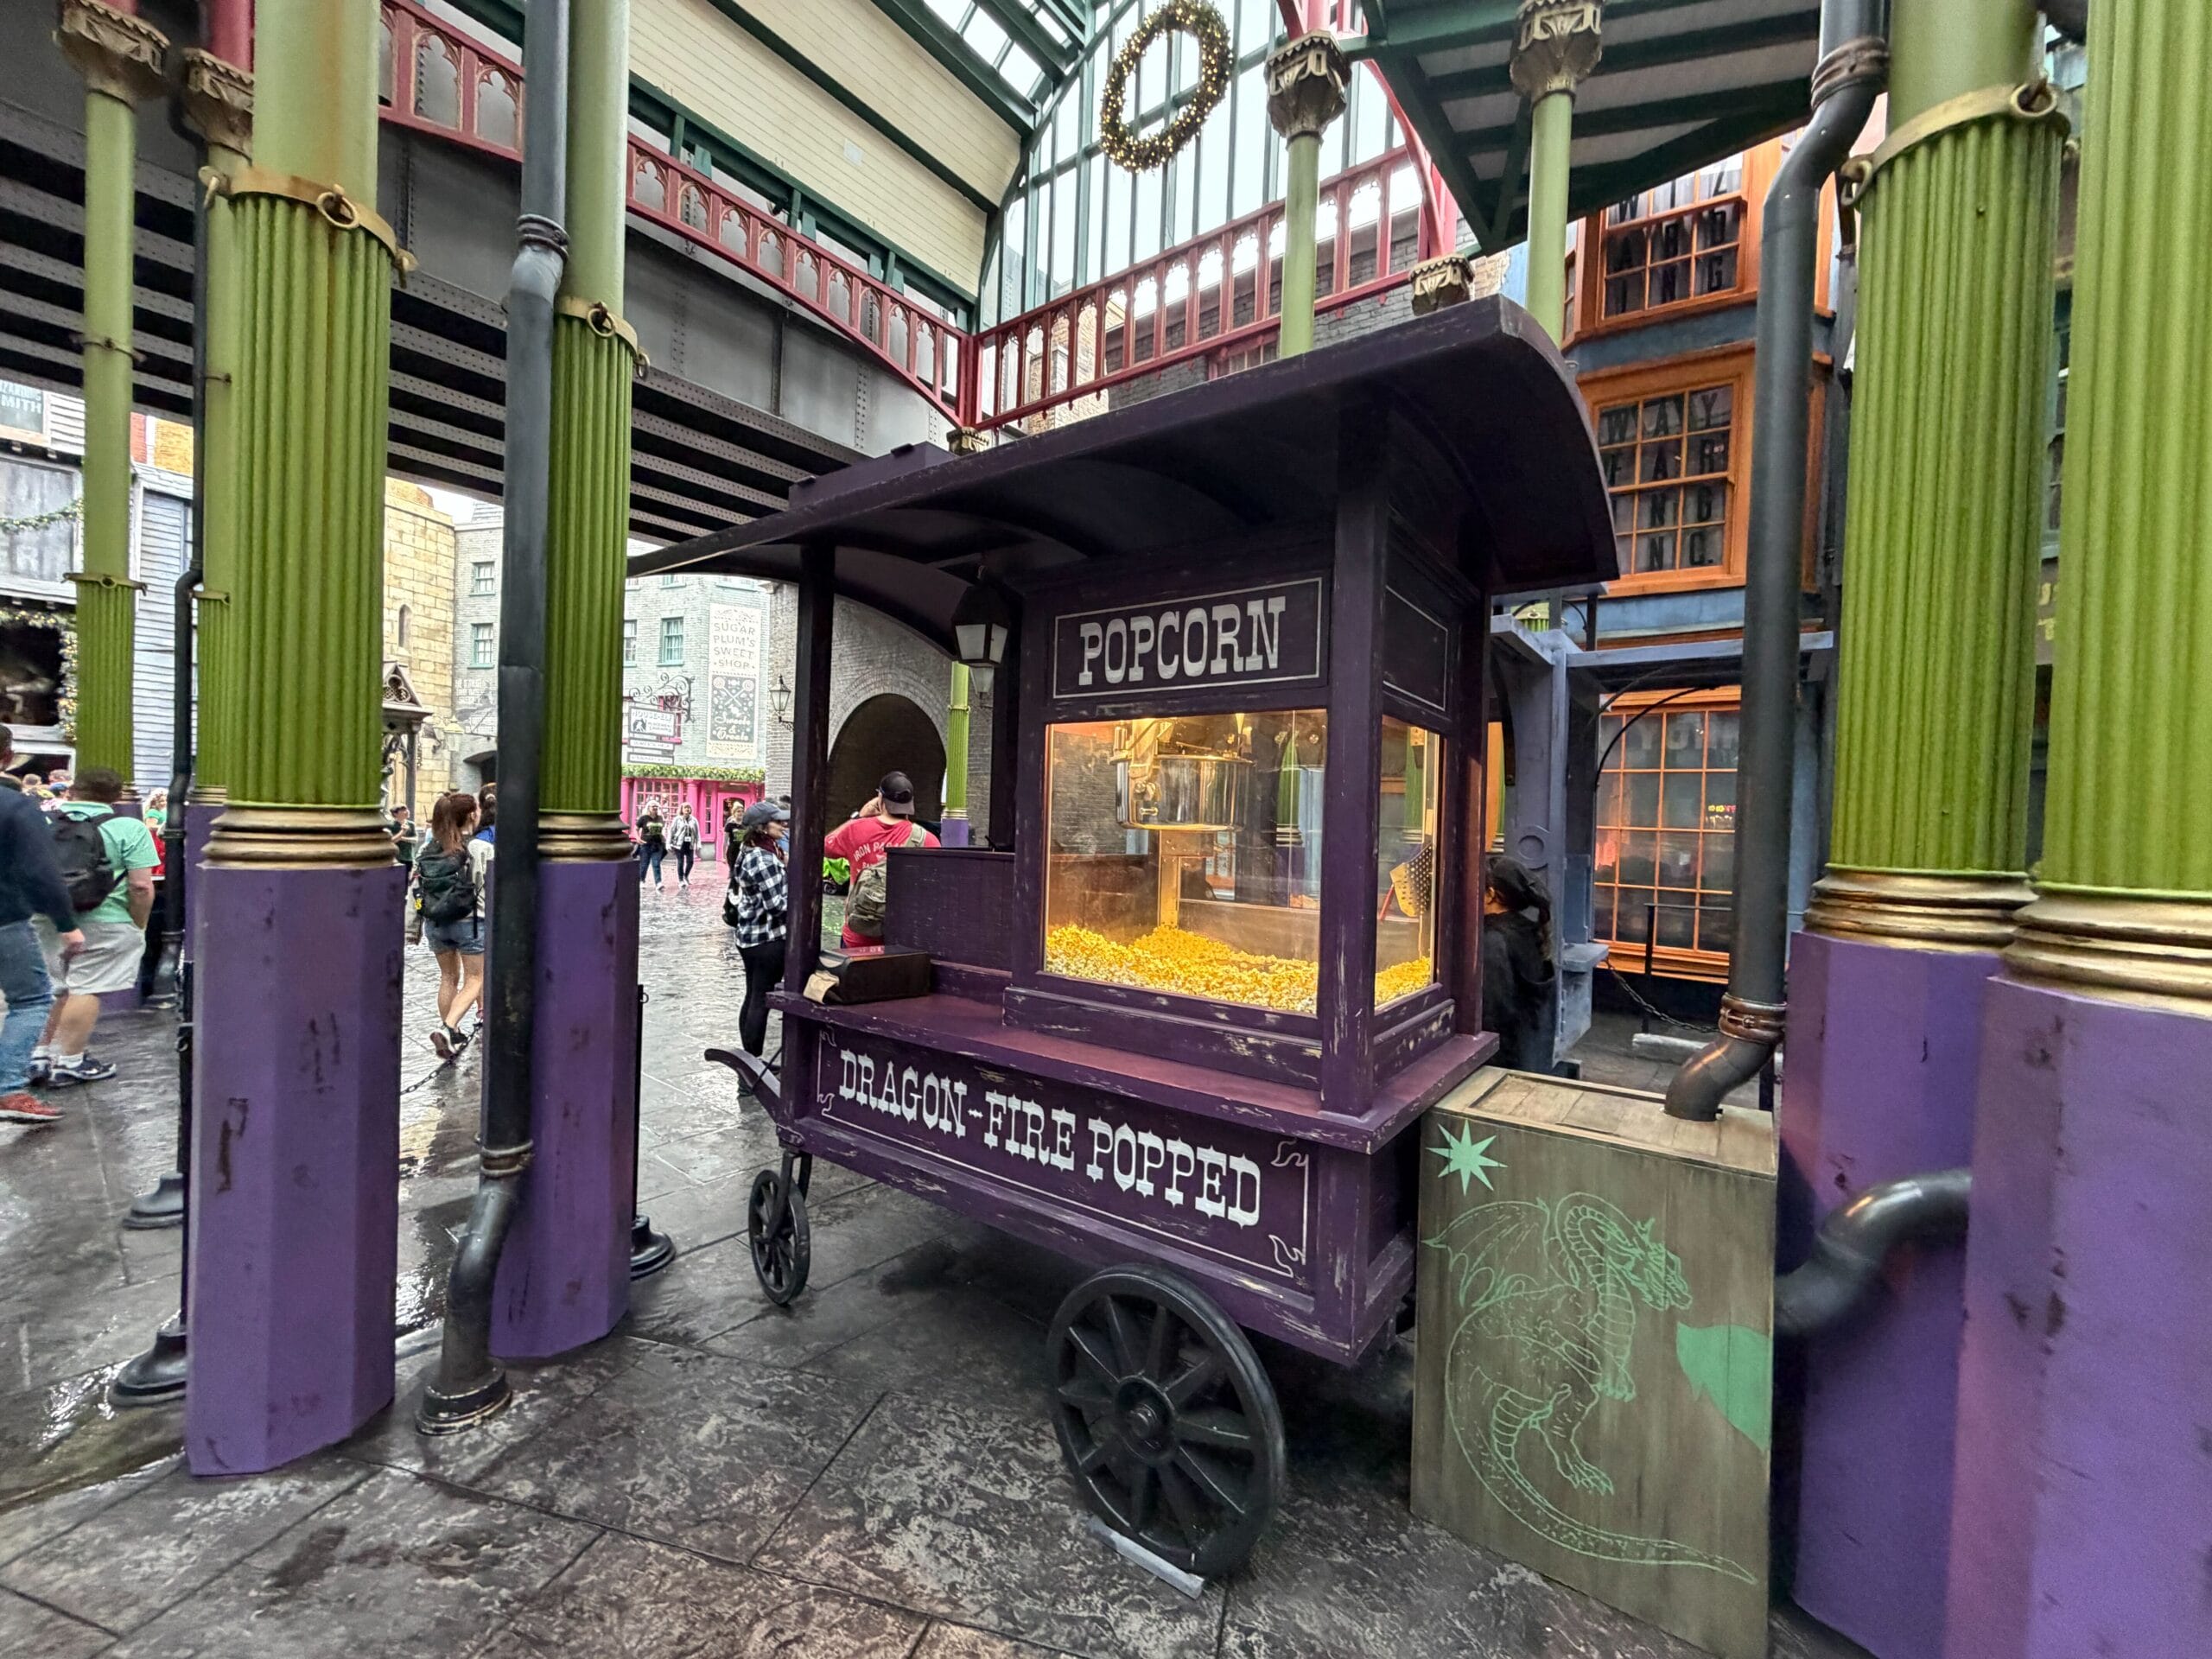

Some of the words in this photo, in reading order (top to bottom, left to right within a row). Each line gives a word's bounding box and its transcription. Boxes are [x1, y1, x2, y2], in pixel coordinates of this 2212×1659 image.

[1606, 393, 1718, 444] WAY
[713, 622, 756, 636] SUGAR
[713, 634, 756, 648] PLUM'S
[1078, 596, 1286, 685] POPCORN
[713, 646, 754, 660] SWEET
[718, 659, 750, 670] SHOP
[853, 842, 871, 861] IRON
[837, 1048, 1076, 1173] DRAGON-FIRE
[1086, 1116, 1262, 1230] POPPED
